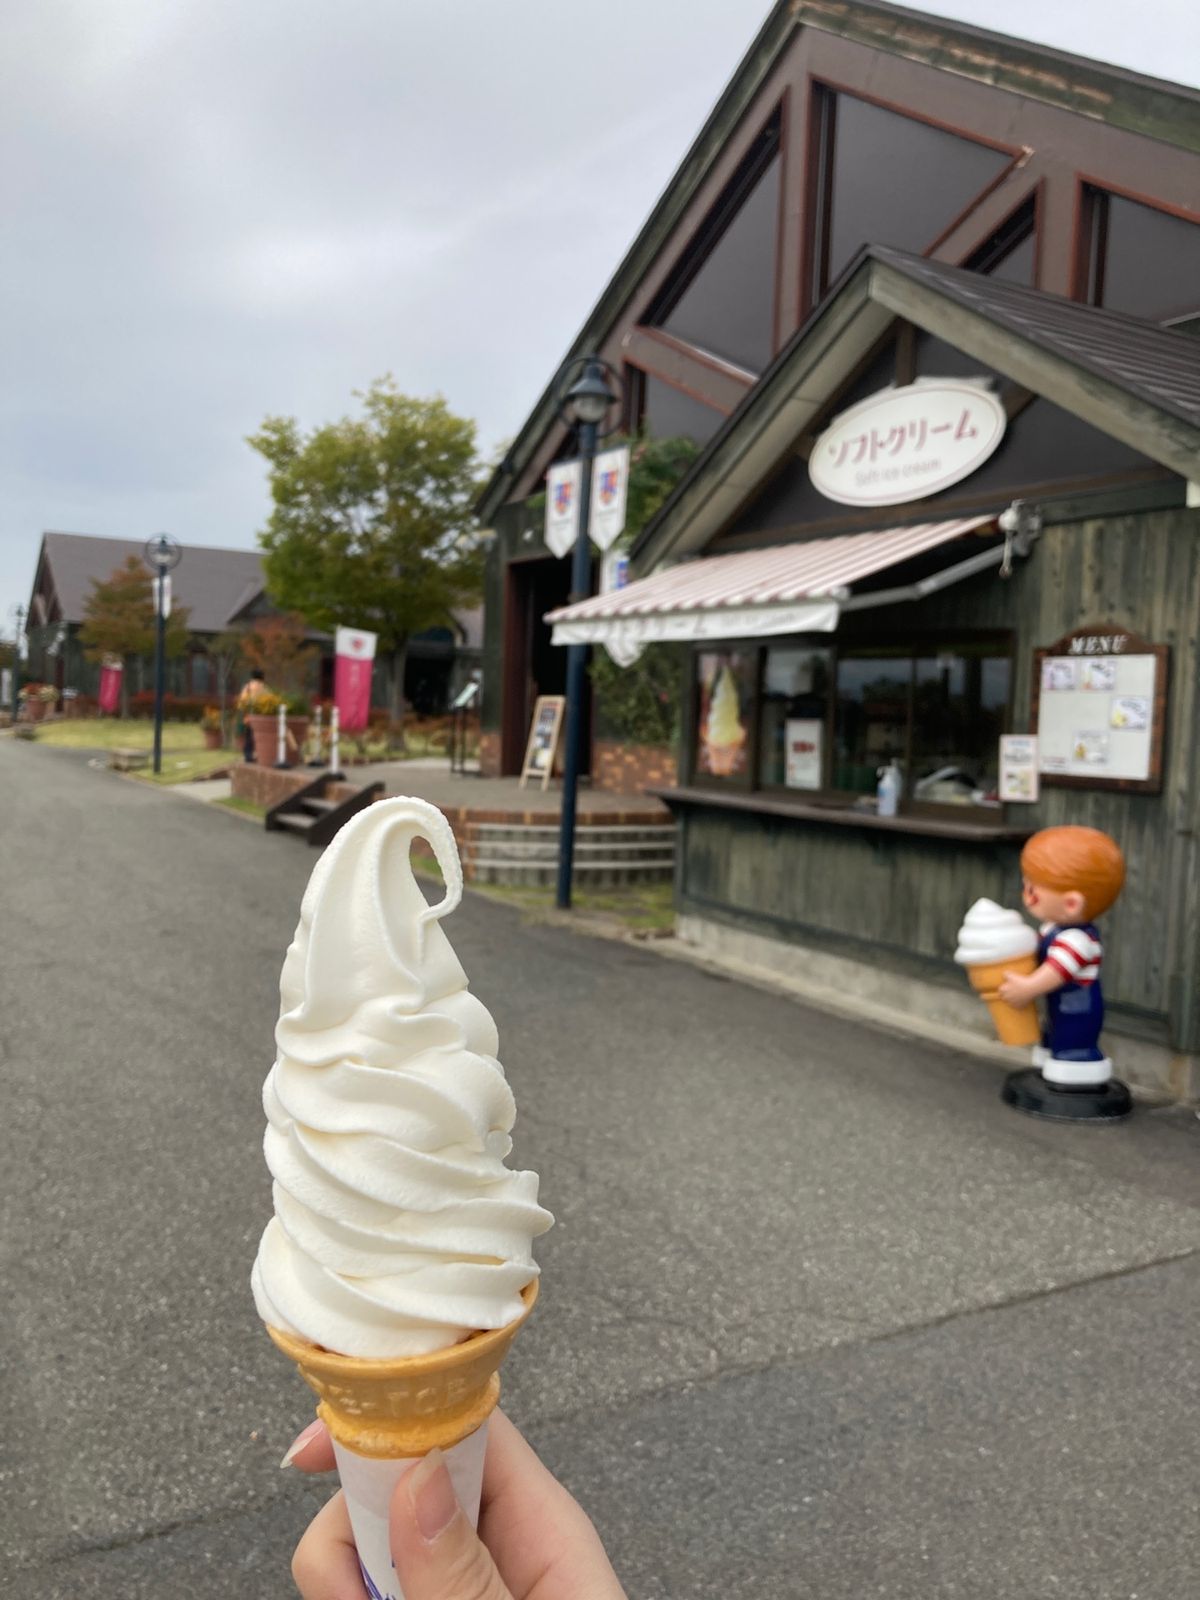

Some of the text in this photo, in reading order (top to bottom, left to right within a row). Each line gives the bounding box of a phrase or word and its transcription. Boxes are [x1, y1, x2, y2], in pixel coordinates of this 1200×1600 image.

[829, 408, 979, 468] ソフトクリーム
[1068, 635, 1128, 655] MENU
